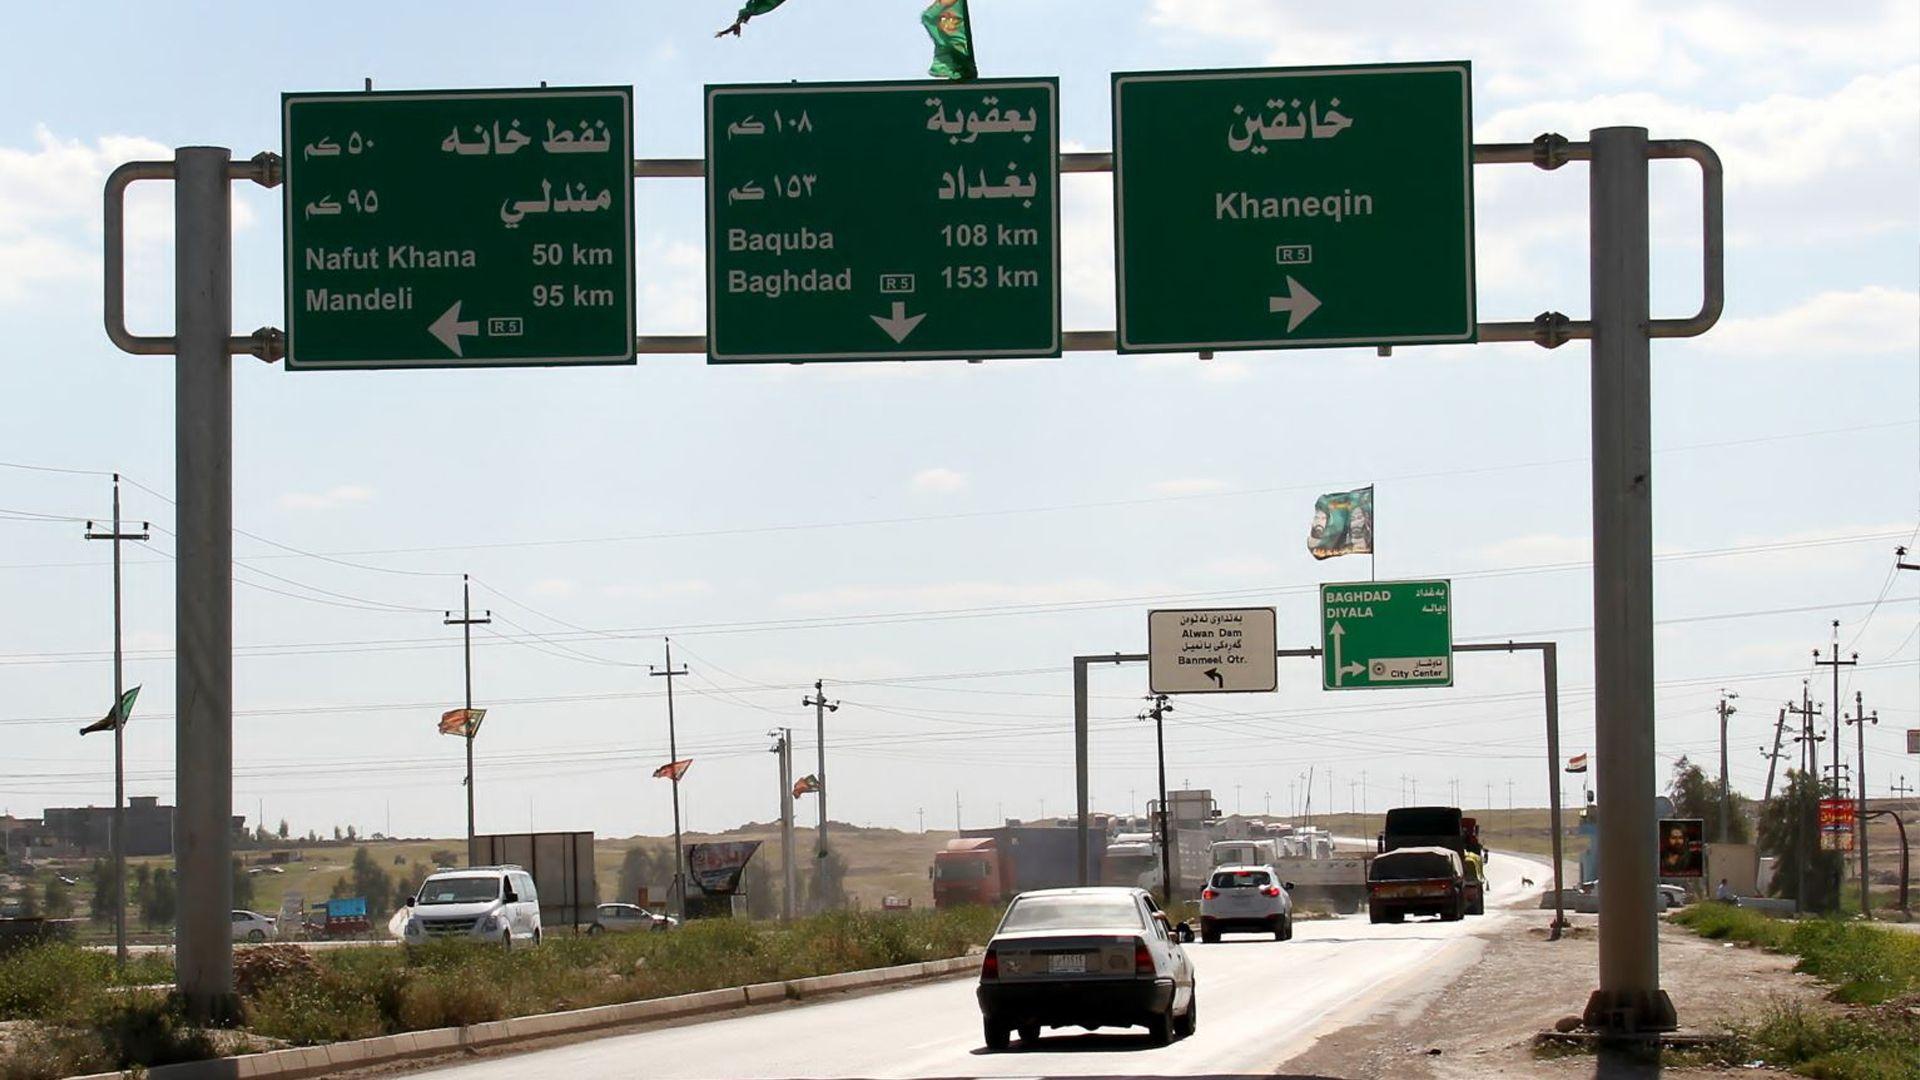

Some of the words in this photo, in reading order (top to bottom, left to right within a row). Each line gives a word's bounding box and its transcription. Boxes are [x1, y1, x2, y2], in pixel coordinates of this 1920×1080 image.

[728, 115, 765, 140] كم
[774, 110, 812, 132] ١٠٨
[925, 96, 1036, 144] بعقوبة
[1228, 98, 1353, 154] خانقين
[349, 132, 373, 154] ٥٠
[442, 119, 531, 155] خانه
[543, 119, 610, 153] نفط
[304, 137, 341, 161] كم
[729, 180, 765, 205] كم
[774, 175, 816, 197] ١٥٣
[939, 162, 1036, 208] بغداد
[306, 195, 341, 220] كم
[348, 190, 378, 212] ٩٥
[501, 178, 611, 228] مندلي
[1216, 189, 1372, 222] Khaneqin
[729, 227, 833, 256] Baquba
[942, 224, 987, 246] 108
[998, 224, 1037, 245] km
[306, 247, 379, 270] Nafut
[389, 246, 475, 268] Khana
[533, 244, 562, 265] 50
[573, 243, 612, 265] km
[729, 268, 851, 298] Baghdad
[942, 266, 987, 288] 153
[998, 266, 1037, 287] km
[307, 287, 412, 311] Mandeli
[533, 285, 564, 306] 95
[574, 285, 613, 306] km
[1326, 591, 1391, 603] BAGHDAD
[1327, 607, 1373, 618] DIYALA
[1182, 629, 1214, 637] Alwan
[1219, 629, 1242, 637] Dam
[1178, 656, 1223, 664] Banmeel
[1391, 670, 1409, 678] City
